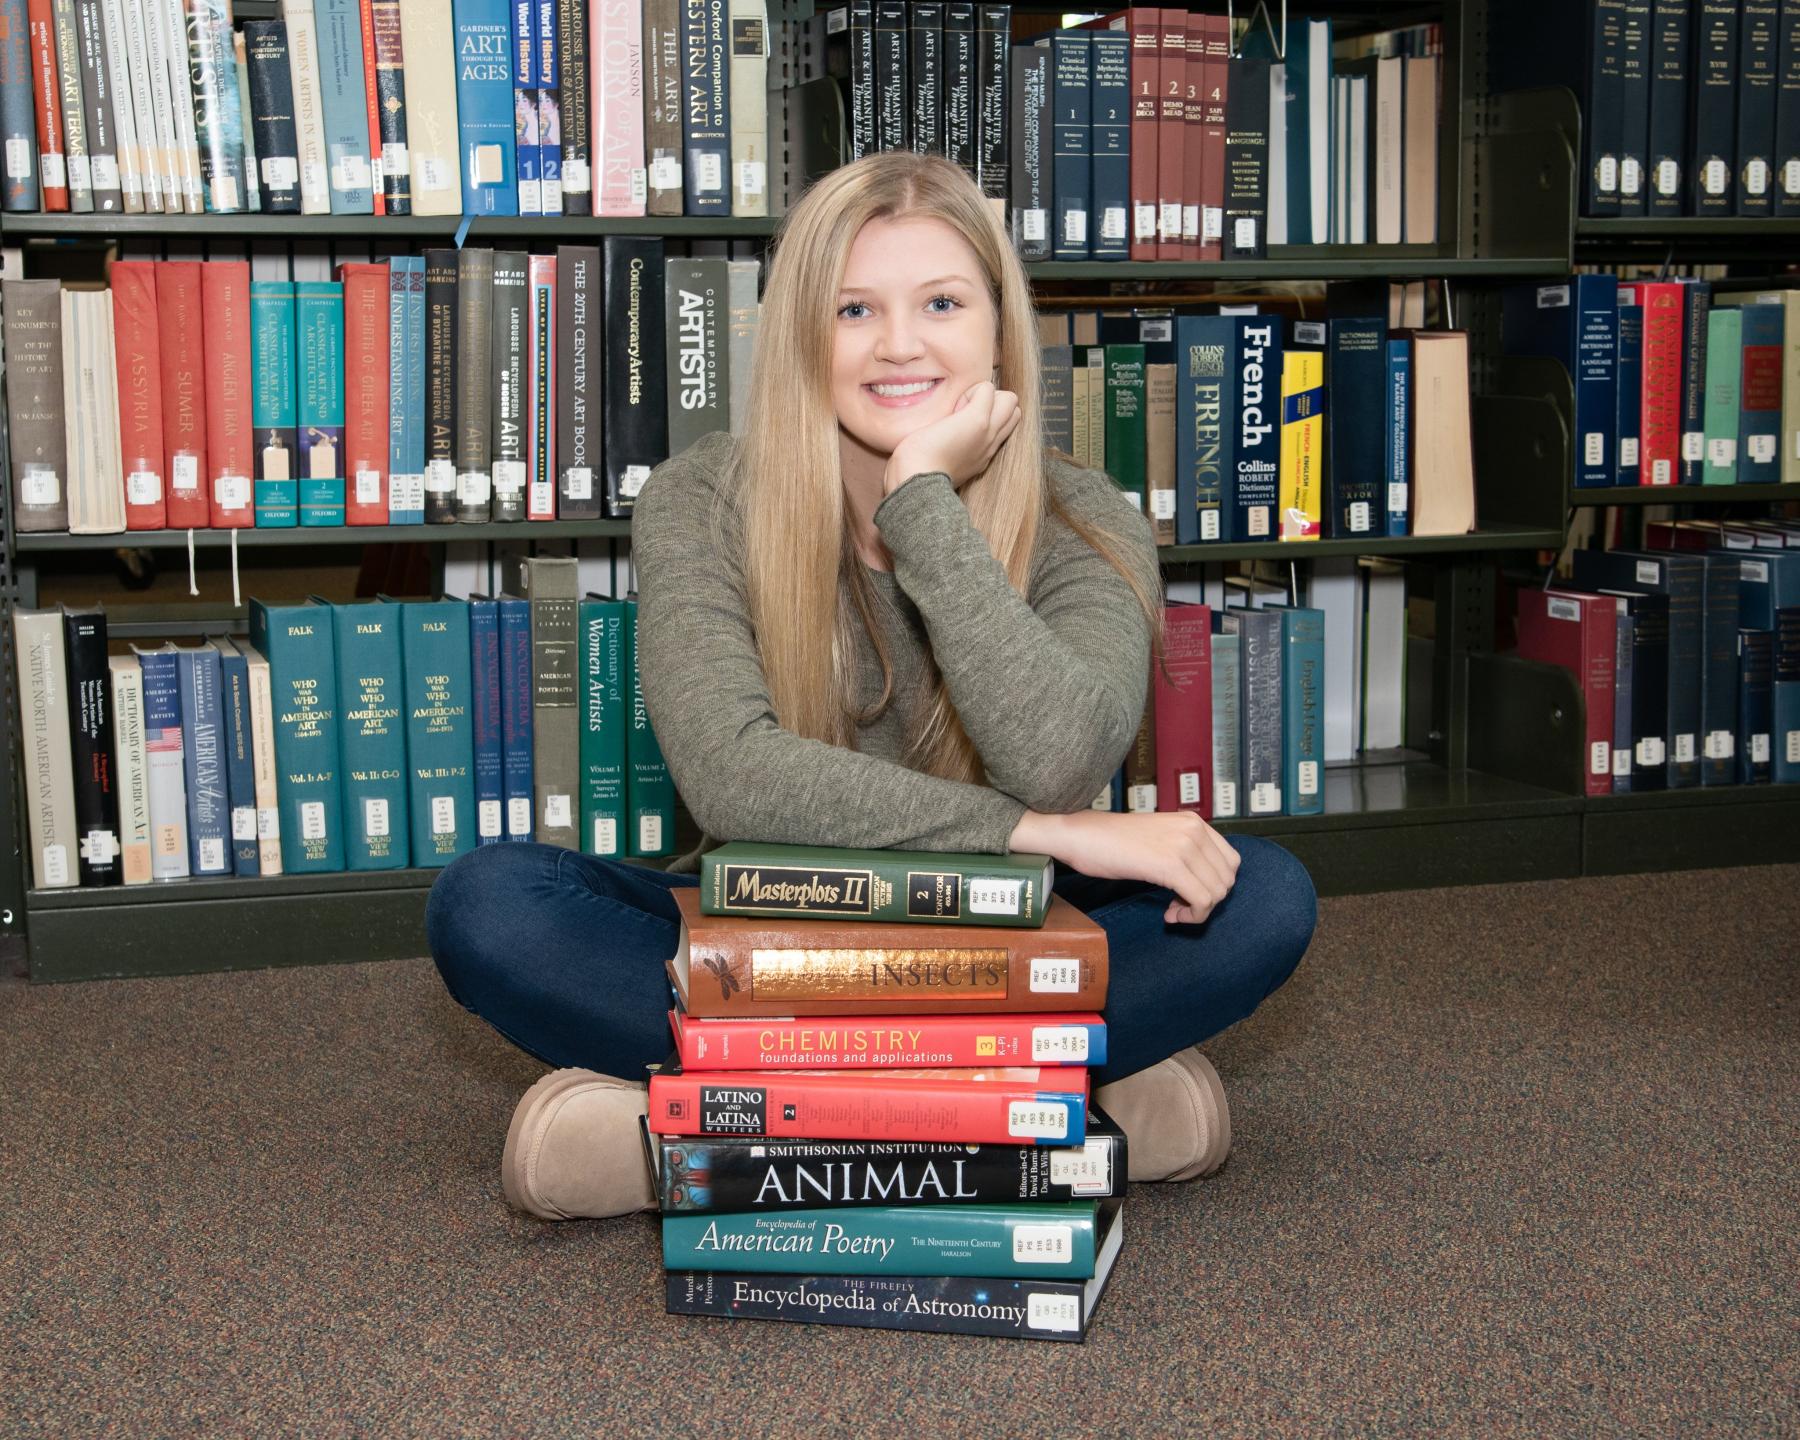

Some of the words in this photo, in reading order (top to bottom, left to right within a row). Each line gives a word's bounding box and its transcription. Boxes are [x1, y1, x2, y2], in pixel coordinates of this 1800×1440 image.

[460, 25, 506, 33] GARDNER'S
[518, 3, 530, 38] World
[540, 3, 552, 38] World
[711, 0, 722, 40] Oxford
[461, 36, 506, 54] ART
[664, 28, 676, 67] THE
[994, 33, 1002, 60] ARTS
[462, 64, 508, 80] AGES
[518, 40, 530, 84] History
[542, 40, 553, 84] History
[630, 45, 640, 97] JANSON
[994, 63, 1001, 72] &
[64, 74, 80, 106] ART
[563, 78, 573, 88] &
[712, 45, 723, 110] Companion
[1141, 82, 1150, 94] 1
[1168, 81, 1178, 94] 2
[574, 61, 586, 148] ENCYCLOPEDIA
[665, 76, 679, 124] ARTS
[1187, 85, 1196, 98] 3
[1212, 88, 1221, 100] 4
[563, 90, 574, 140] ANCIENT
[690, 85, 708, 128] ART
[983, 85, 994, 126] Through
[617, 111, 632, 135] OF
[714, 114, 723, 126] to
[985, 128, 993, 140] the
[523, 162, 533, 179] 1
[545, 160, 558, 179] 2
[606, 134, 632, 196] ART
[574, 260, 585, 288] THE
[575, 292, 585, 324] 20TH
[511, 308, 519, 352] LAROUSSE
[574, 328, 585, 392] CENTURY
[678, 290, 706, 410] ARTISTS
[706, 288, 716, 408] CONTEMPORARY
[132, 352, 148, 432] ASSYRIA
[511, 356, 519, 418] ENCYCLOPEDIA
[1243, 326, 1272, 448] French
[178, 371, 194, 433] SUMER
[574, 396, 585, 424] ART
[501, 421, 519, 458] ART
[574, 426, 585, 466] BOOK
[1196, 383, 1220, 508] FRENCH
[1238, 460, 1276, 473] Collins
[1238, 473, 1275, 482] ROBERT
[1239, 484, 1275, 493] Dictionary
[288, 626, 313, 636] FALK
[356, 624, 382, 634] FALK
[422, 622, 447, 632] FALK
[588, 618, 604, 679] Women
[608, 618, 620, 686] Dictionary
[31, 645, 44, 687] NATIVE
[360, 678, 384, 687] WHO
[610, 689, 620, 701] of
[33, 690, 47, 734] NORTH
[360, 694, 384, 703] WHO
[590, 681, 604, 732] Artists
[347, 709, 399, 720] AMERICAN
[364, 718, 383, 728] ART
[36, 736, 51, 799] AMERICAN
[352, 772, 368, 780] Vol.
[382, 770, 400, 779] G-O
[730, 870, 840, 908] Masterplots
[840, 877, 867, 905] II
[916, 890, 928, 900] 2
[871, 963, 1000, 986] INSECTS
[760, 1030, 922, 1051] CHEMISTRY
[760, 1052, 837, 1063] foundations
[843, 1052, 867, 1063] and
[872, 1052, 953, 1064] applications
[705, 1091, 762, 1104] LATINO
[705, 1112, 760, 1125] LATINA
[769, 1145, 865, 1156] SMITHSONIAN
[870, 1143, 962, 1154] INSTITUTION
[752, 1160, 978, 1203] ANIMAL
[1040, 1180, 1048, 1194] Don
[755, 1219, 806, 1230] Encyclopedia
[807, 1220, 817, 1231] of
[695, 1220, 813, 1253] American
[820, 1224, 894, 1262] Poetry
[1027, 1240, 1032, 1250] PS
[696, 1284, 703, 1292] &
[843, 1280, 865, 1288] THE
[870, 1281, 914, 1291] FIREFLY
[733, 1281, 875, 1314] Encyclopedia
[883, 1298, 900, 1312] of
[904, 1293, 1026, 1326] Astronomy
